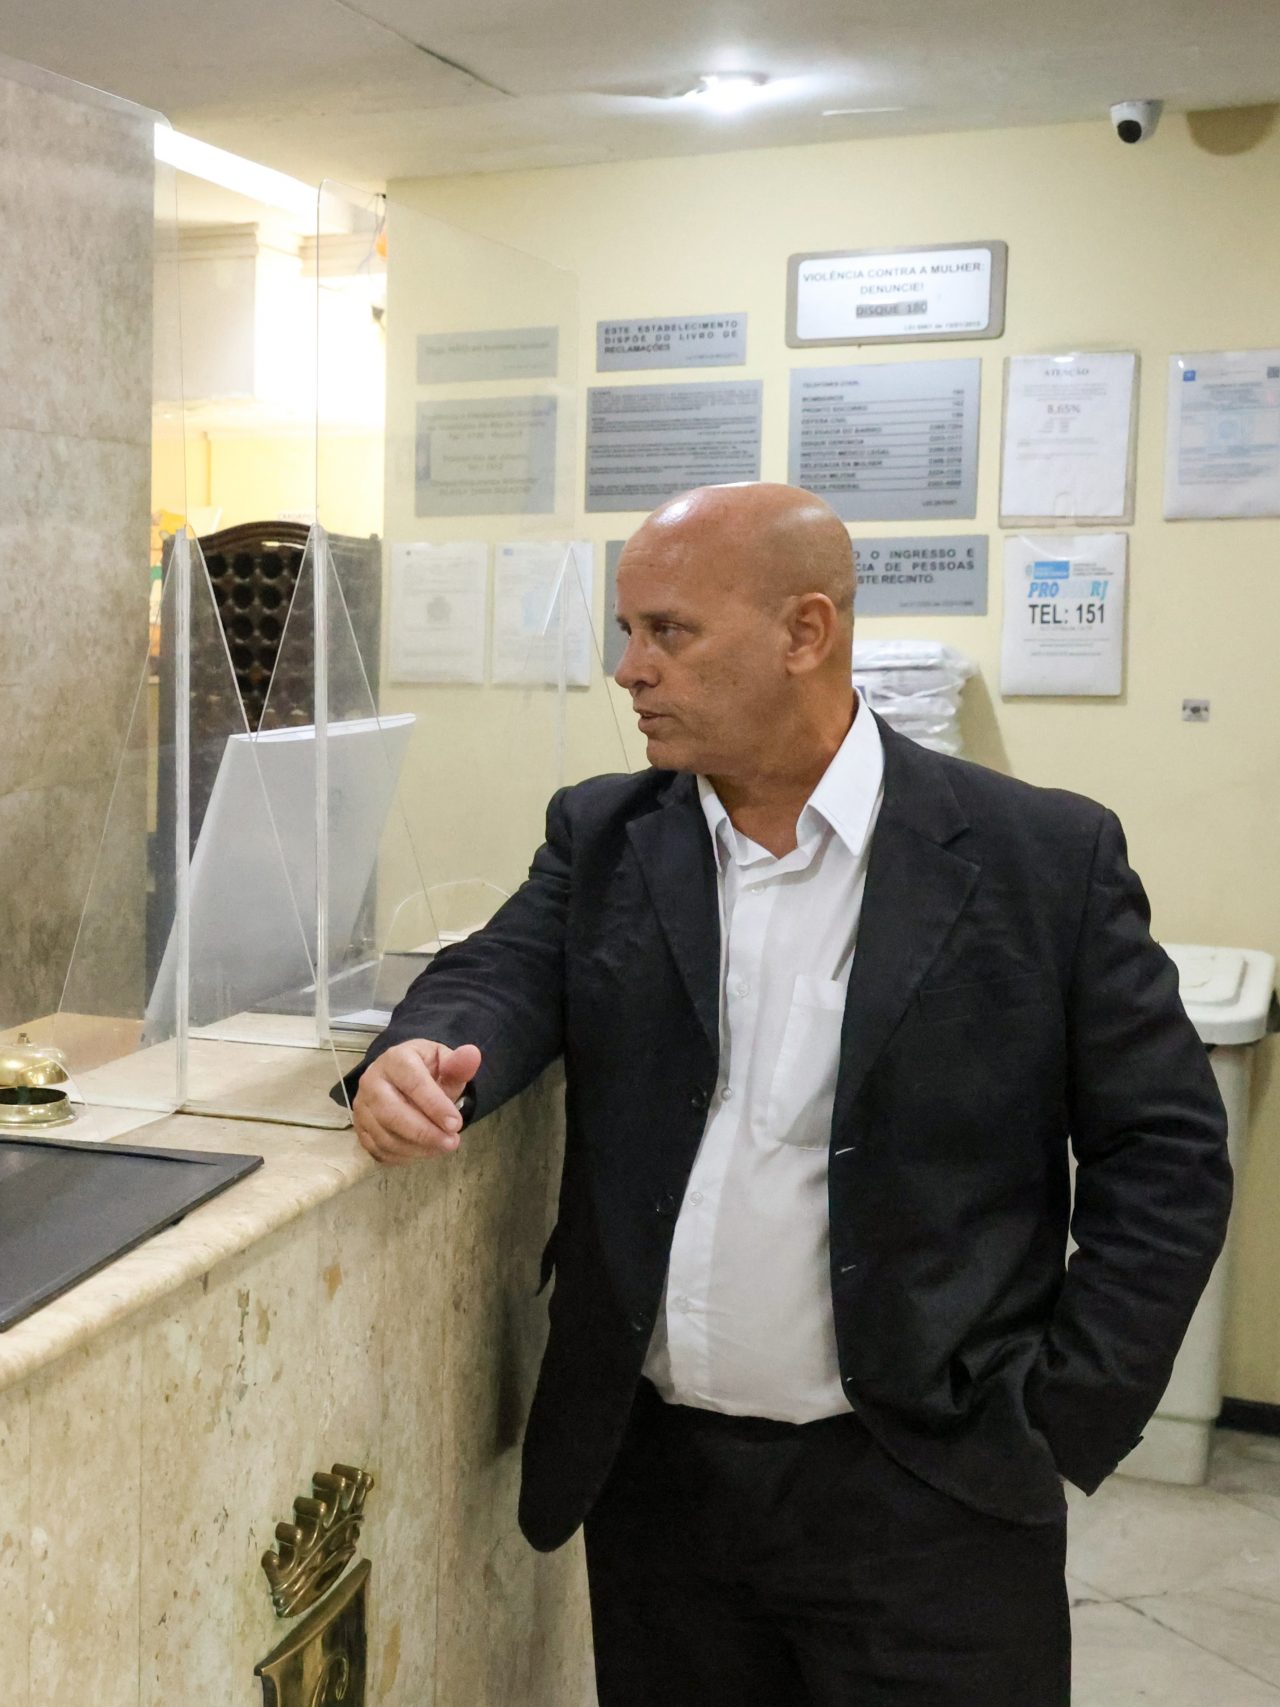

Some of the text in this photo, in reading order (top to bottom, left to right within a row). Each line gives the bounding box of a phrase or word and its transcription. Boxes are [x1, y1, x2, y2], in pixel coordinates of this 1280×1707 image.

[803, 268, 864, 282] VIOLÊNCIA
[867, 266, 916, 279] CONTRA
[919, 265, 927, 275] A
[860, 282, 924, 295] DENUNCIE!
[855, 302, 927, 318] DISQUE 180
[604, 320, 739, 335] ESTE ESTABELECIMENTO
[604, 330, 738, 345] DISPÕE DO LIVRO DE
[604, 343, 671, 354] RECLAMAÇÕES
[1044, 368, 1090, 378] ATENÇÃO
[870, 550, 880, 560] O
[889, 549, 957, 559] INGRESSO
[966, 547, 975, 558] E
[884, 562, 902, 572] DE
[912, 560, 975, 571] PESSOAS
[1027, 580, 1109, 601] PRO RJ
[1028, 603, 1105, 624] TEL: 151
